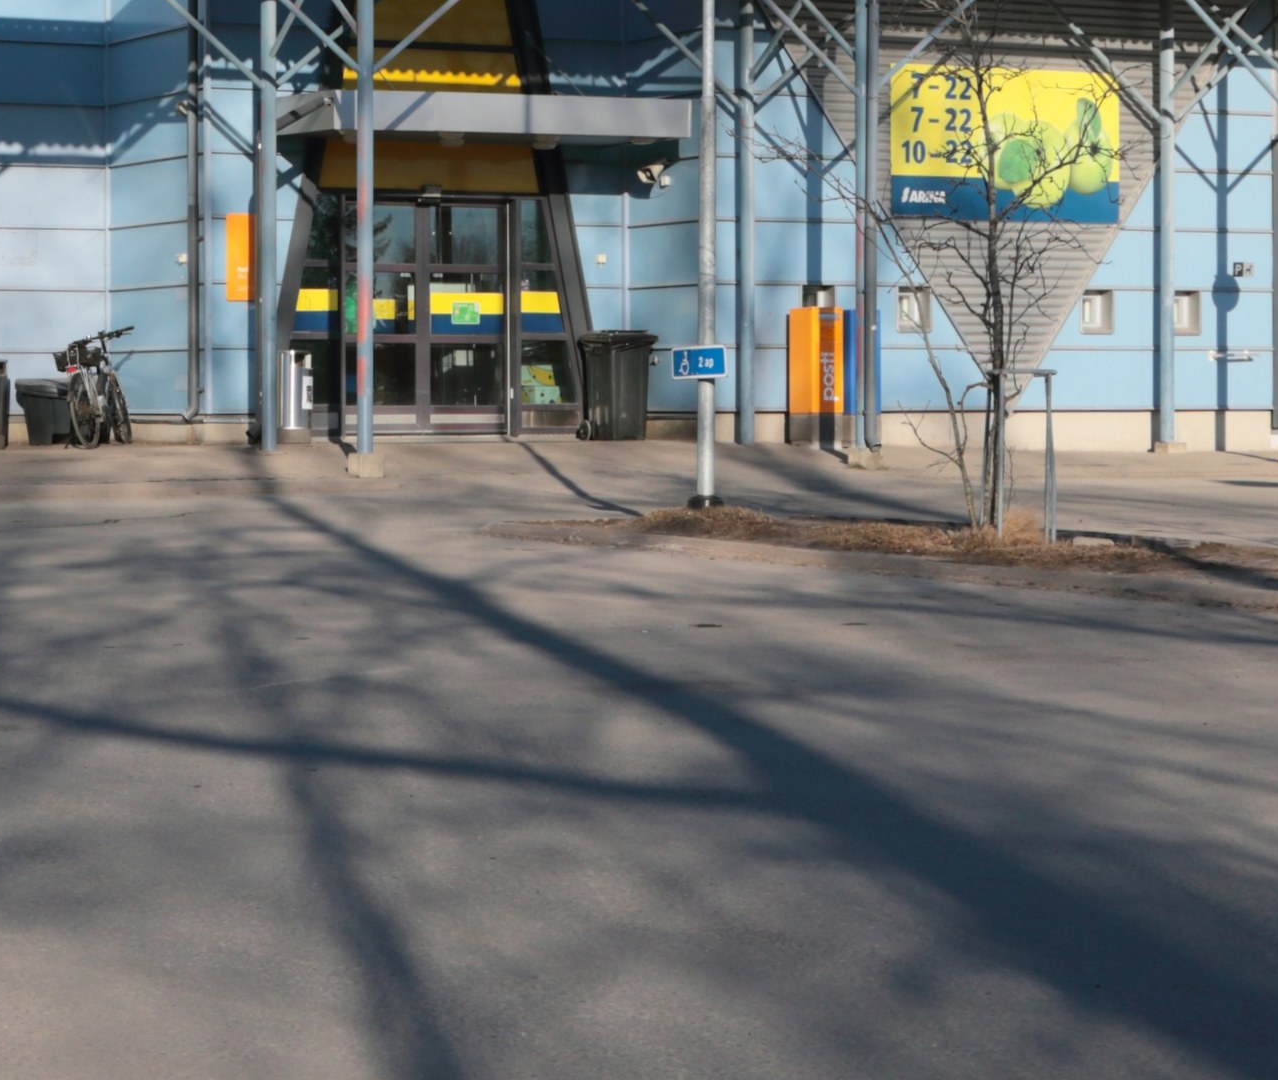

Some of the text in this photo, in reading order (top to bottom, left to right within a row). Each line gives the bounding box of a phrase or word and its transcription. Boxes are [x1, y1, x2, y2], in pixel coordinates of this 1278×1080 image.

[944, 74, 972, 101] 22
[944, 107, 972, 133] 22
[901, 140, 926, 164] 10
[820, 352, 839, 402] posti
